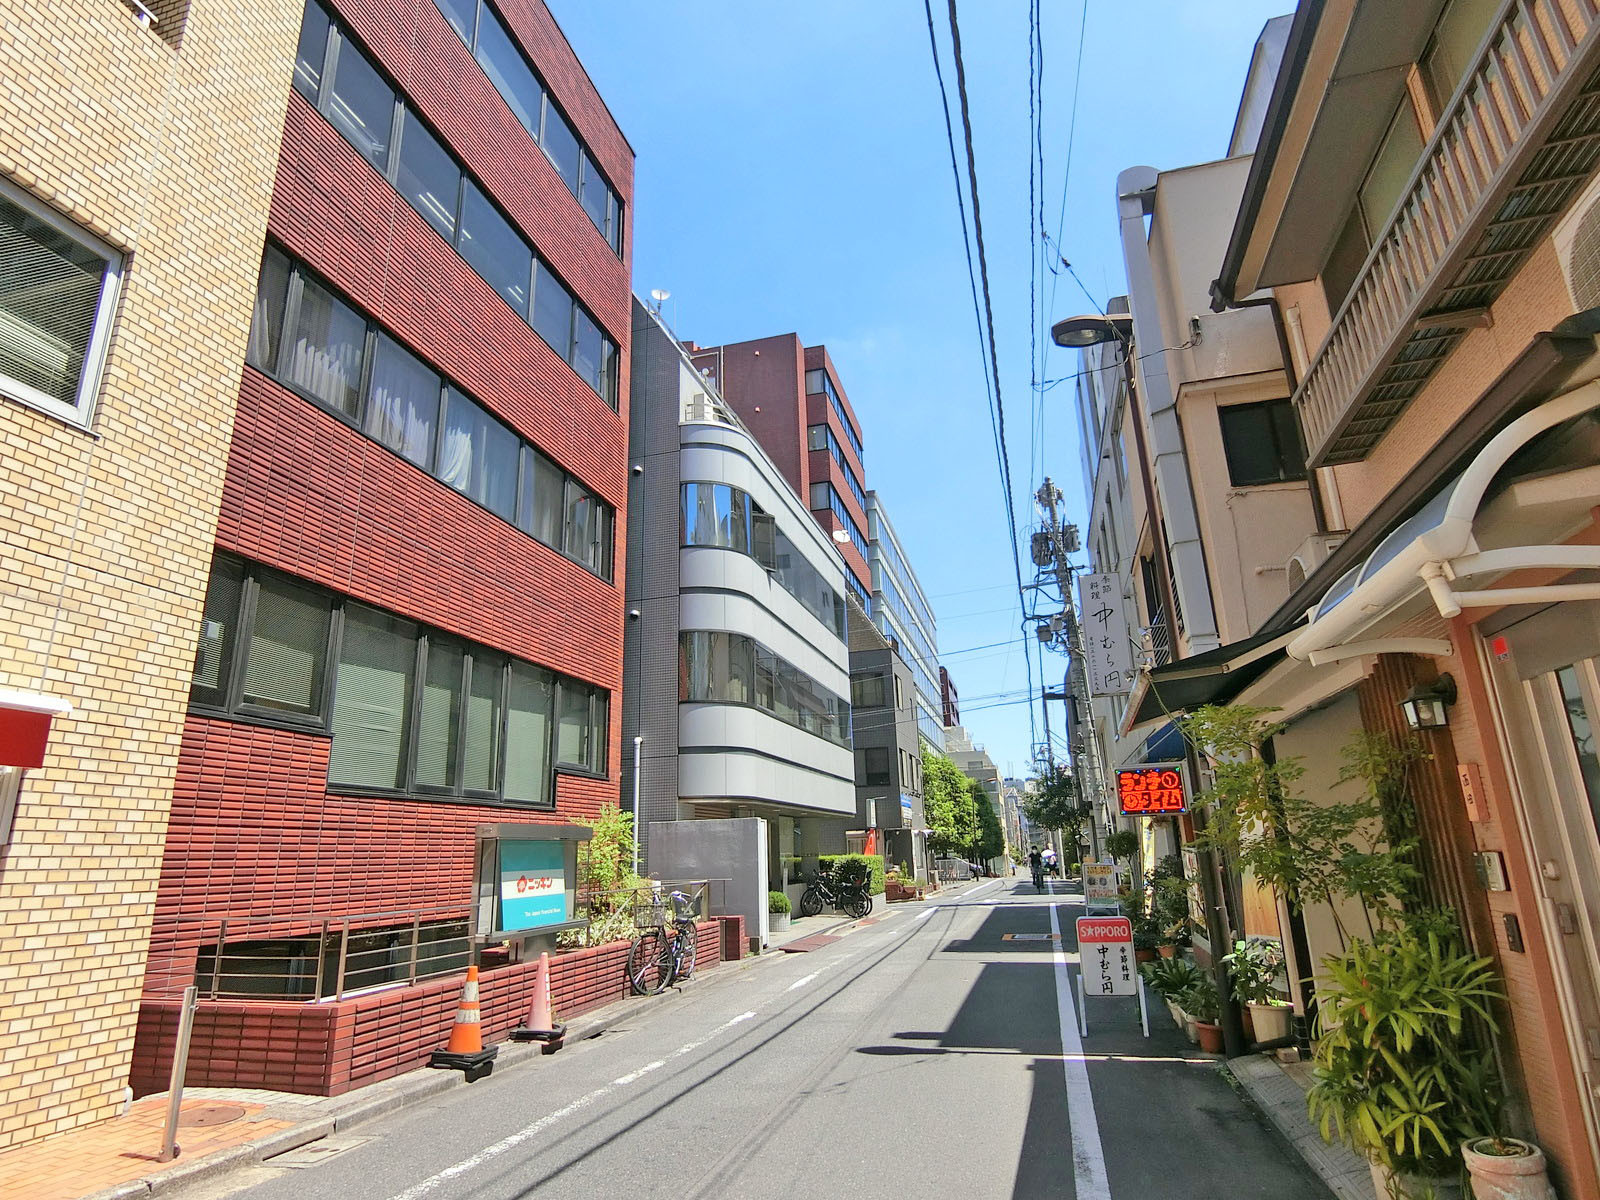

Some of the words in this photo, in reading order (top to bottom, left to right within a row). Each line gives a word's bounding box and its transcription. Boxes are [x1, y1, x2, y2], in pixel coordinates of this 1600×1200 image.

[1091, 601, 1121, 688] 中むら円
[1120, 772, 1161, 791] ランチ
[1141, 791, 1181, 808] タイム
[528, 877, 553, 890] ニッキン
[1096, 944, 1113, 994] 中むら円
[1119, 945, 1130, 982] 季節料理
